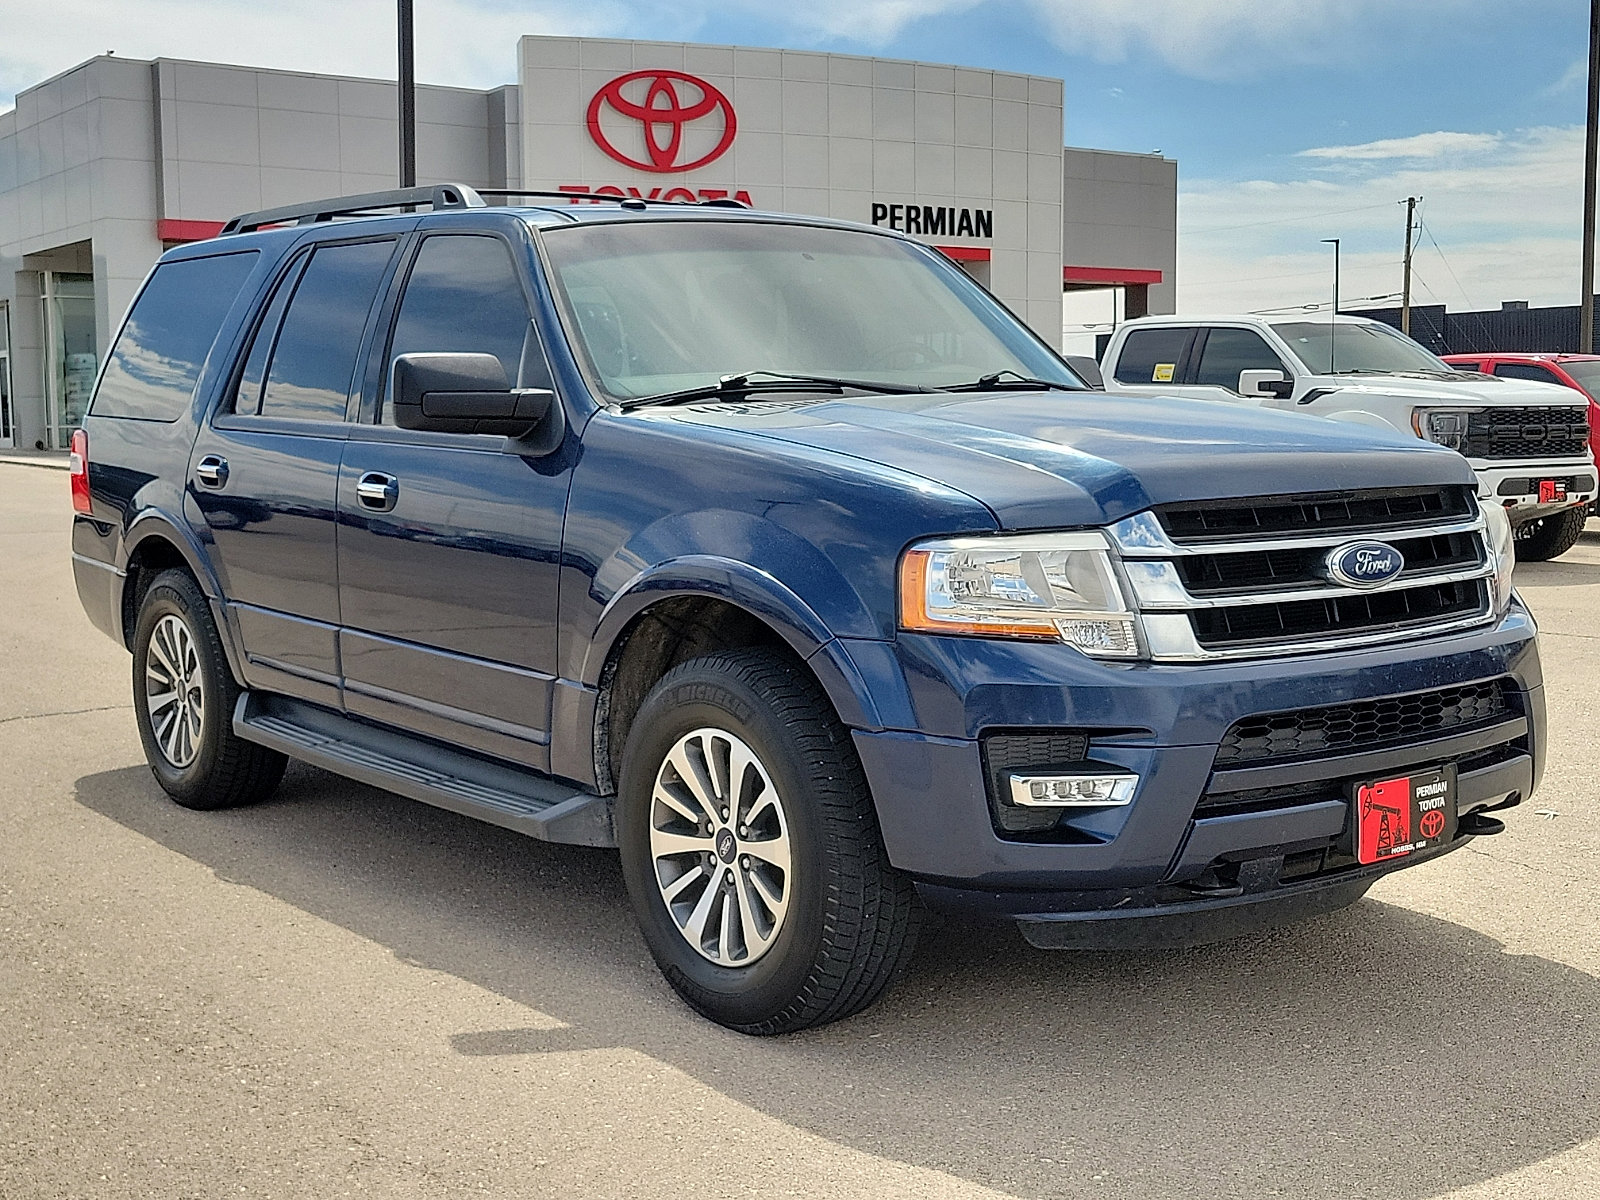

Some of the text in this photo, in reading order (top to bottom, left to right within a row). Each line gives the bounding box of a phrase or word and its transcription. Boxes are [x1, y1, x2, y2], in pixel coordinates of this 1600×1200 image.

[872, 203, 992, 238] PERMIAN
[1355, 550, 1392, 575] Ford
[1416, 781, 1447, 798] PERMIAN
[1418, 796, 1445, 812] TOYOTA
